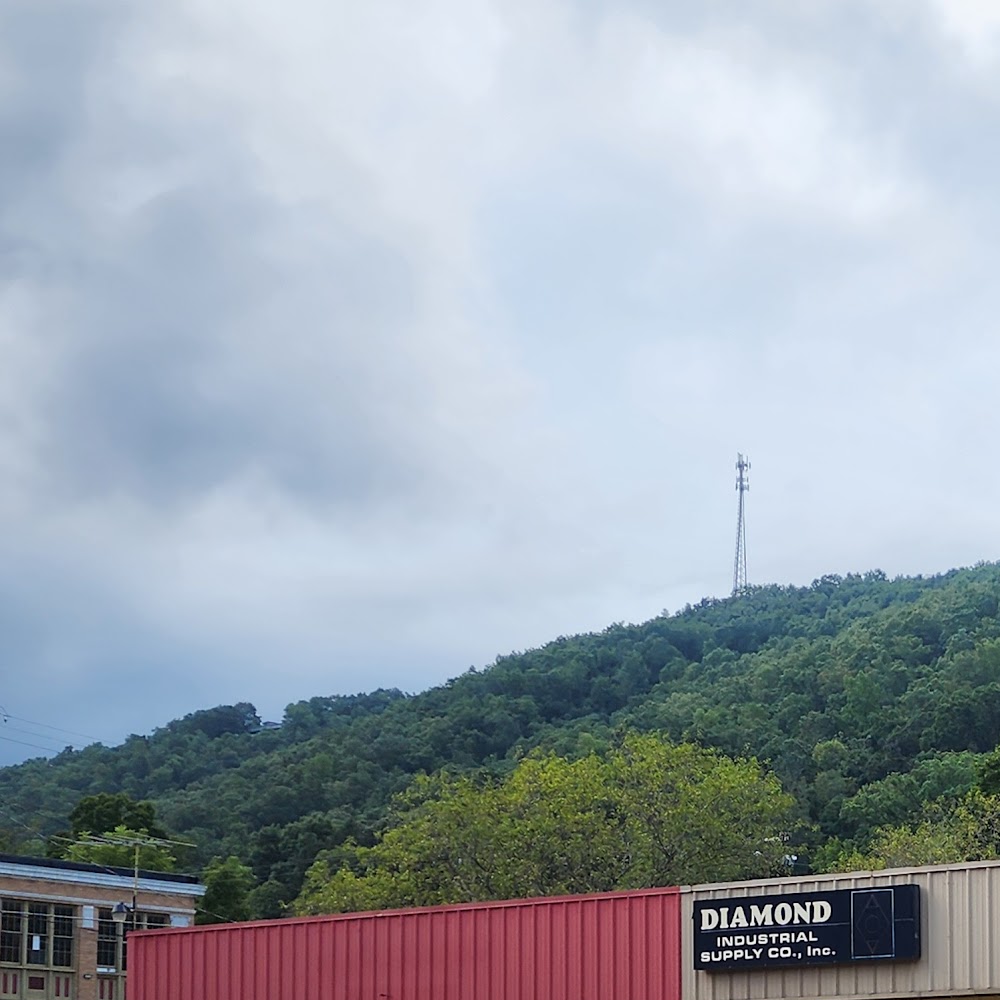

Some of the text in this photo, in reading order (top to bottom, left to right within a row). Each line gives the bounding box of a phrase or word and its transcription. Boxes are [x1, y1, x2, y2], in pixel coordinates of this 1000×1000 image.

[700, 901, 832, 930] DIAMOND
[717, 931, 818, 947] INDUSTRIAL
[700, 945, 836, 962] SUPPLY CO., Inc.
